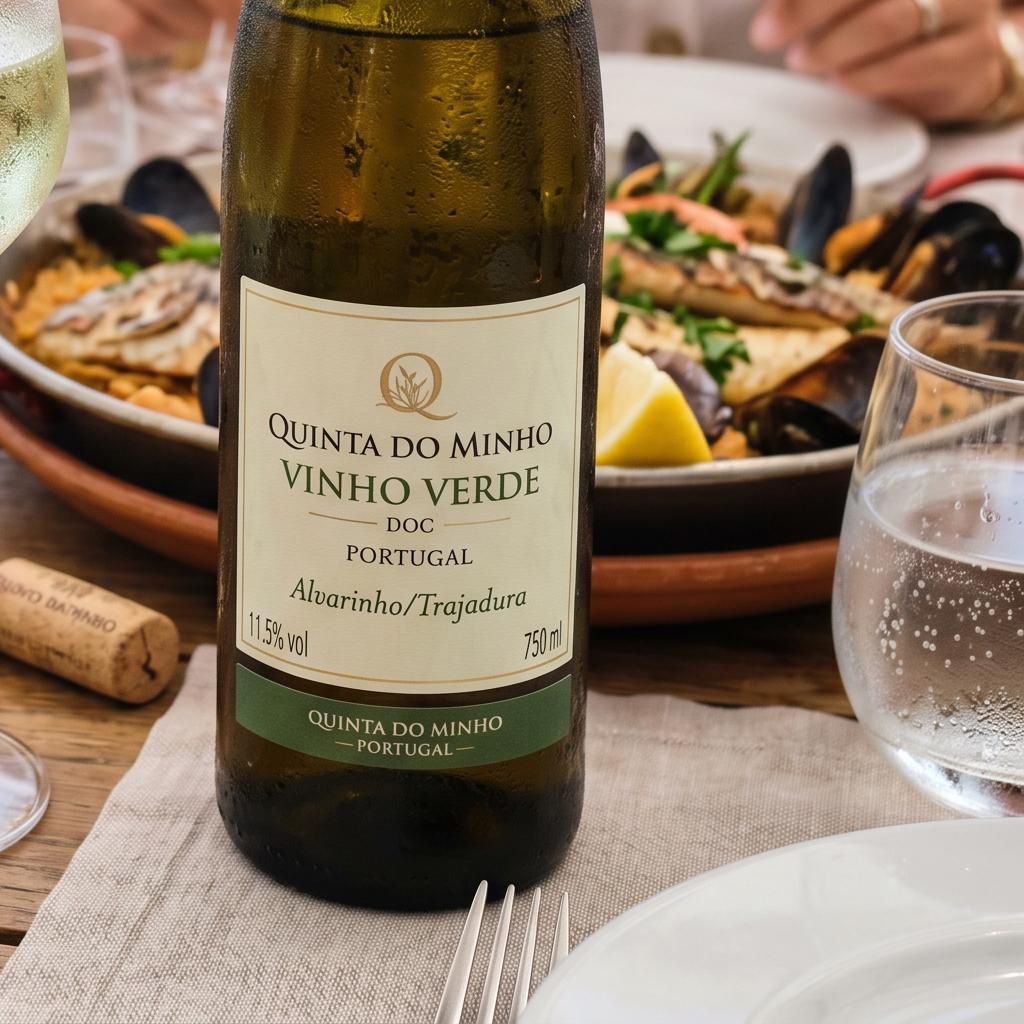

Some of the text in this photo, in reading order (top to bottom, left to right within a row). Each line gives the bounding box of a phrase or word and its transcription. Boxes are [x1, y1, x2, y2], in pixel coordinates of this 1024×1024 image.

[268, 412, 553, 459] QUINTA DO MINHO
[279, 458, 539, 507] VINHO VERDE
[386, 517, 434, 534] DOC
[346, 544, 473, 567] PORTUGAL
[289, 577, 527, 625] Alvarinho/Trajadura
[249, 611, 309, 657] 11.5% vol
[524, 620, 563, 660] 750 ml
[308, 709, 503, 738] QUINTA DO MINHO
[357, 740, 453, 757] PORTUGAL
